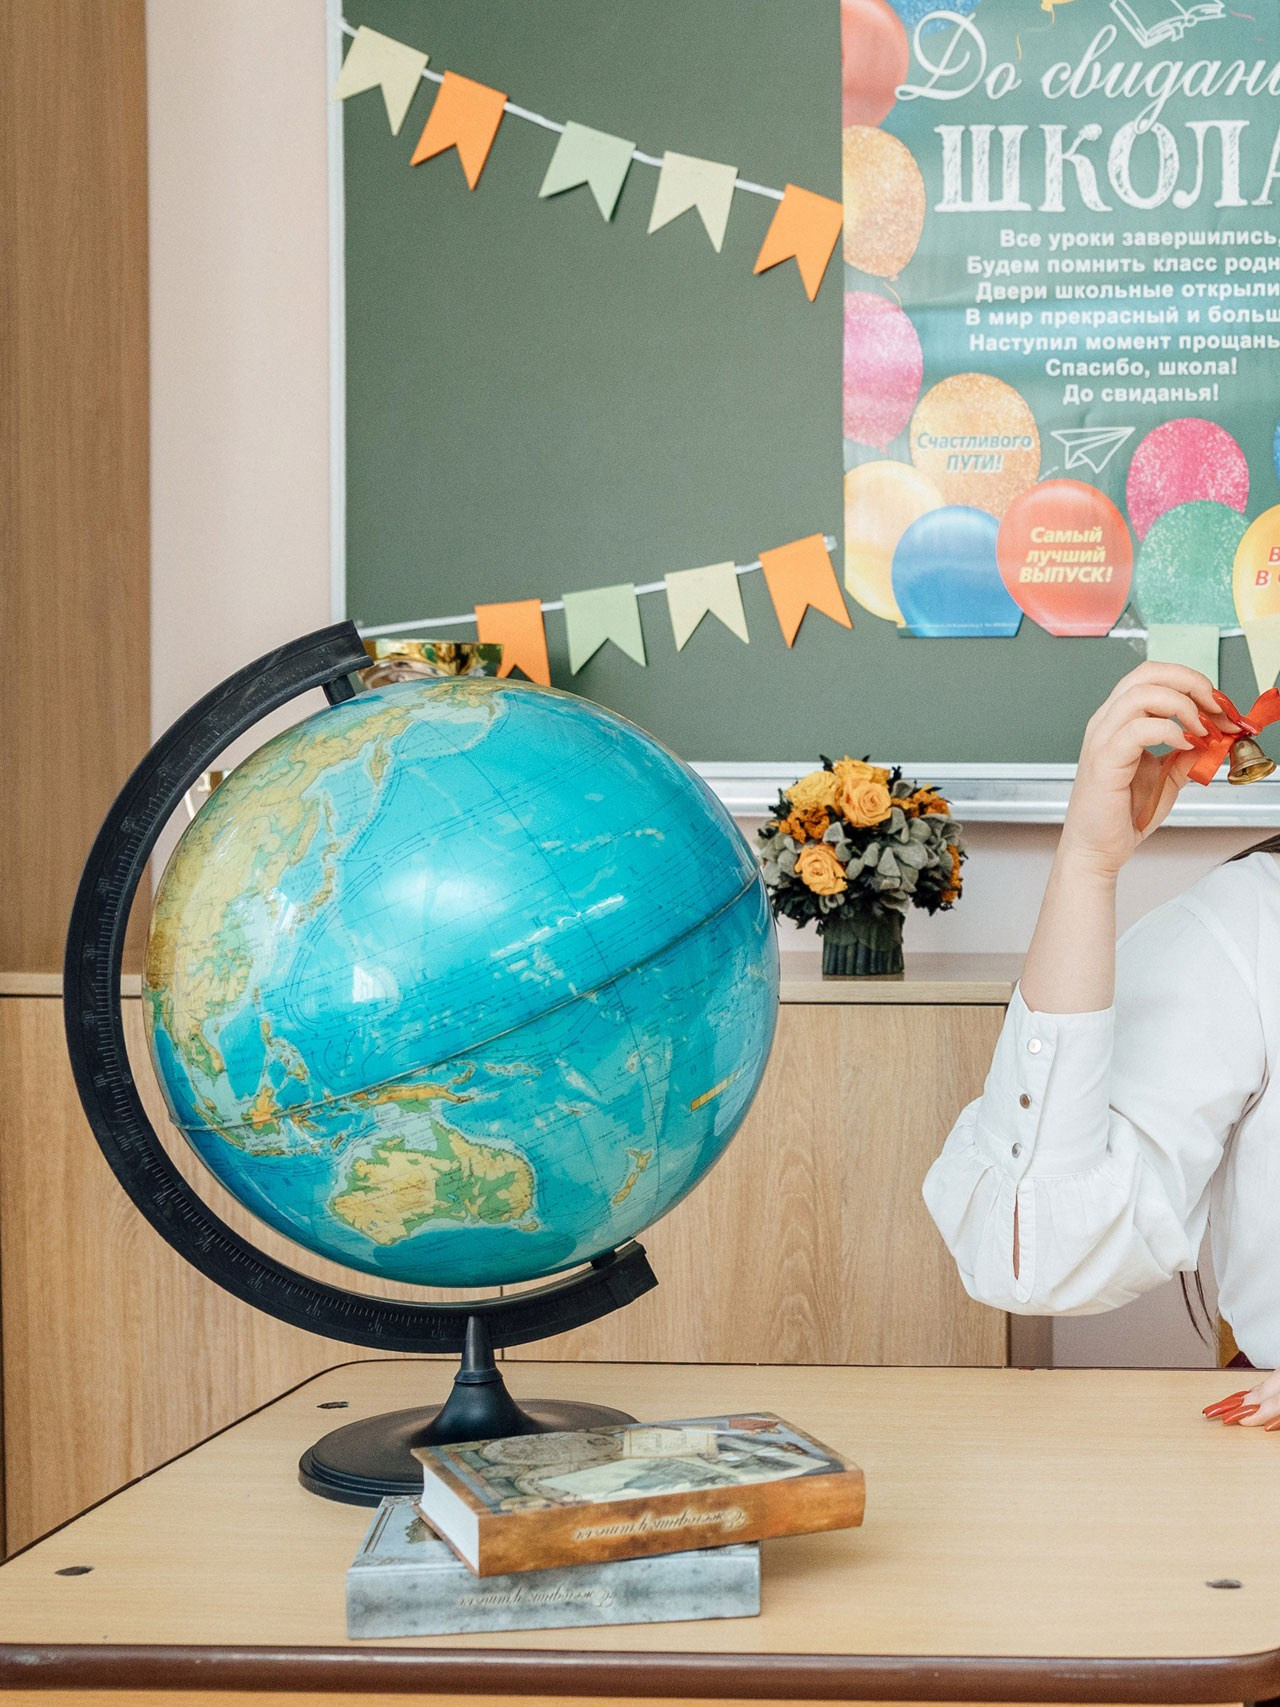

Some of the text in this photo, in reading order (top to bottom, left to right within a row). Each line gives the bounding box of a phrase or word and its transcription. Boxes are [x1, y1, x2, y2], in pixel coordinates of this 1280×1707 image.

[894, 10, 1023, 101] До
[1000, 229, 1042, 248] Все
[1049, 230, 1115, 251] уроки
[967, 256, 1040, 278] Будем
[1047, 256, 1146, 274] помнить
[1153, 255, 1218, 272] класс
[975, 282, 1048, 303] Двери
[1056, 281, 1174, 299] школьные
[965, 308, 982, 326] В
[988, 310, 1033, 329] мир
[1041, 305, 1179, 327] прекрасный
[1187, 308, 1200, 323] и
[969, 333, 1078, 355] Наступил
[1085, 333, 1172, 351] момент
[1045, 357, 1238, 379] Спасибо, школа!
[1063, 383, 1220, 405] До свиданья!
[916, 431, 1034, 451] Счастливого
[945, 453, 1005, 473] ПУТИ!
[1030, 526, 1103, 545] Самый
[1025, 545, 1107, 566] лучший
[1018, 565, 1113, 584] ВЫПУСК!
[1255, 570, 1269, 587] В
